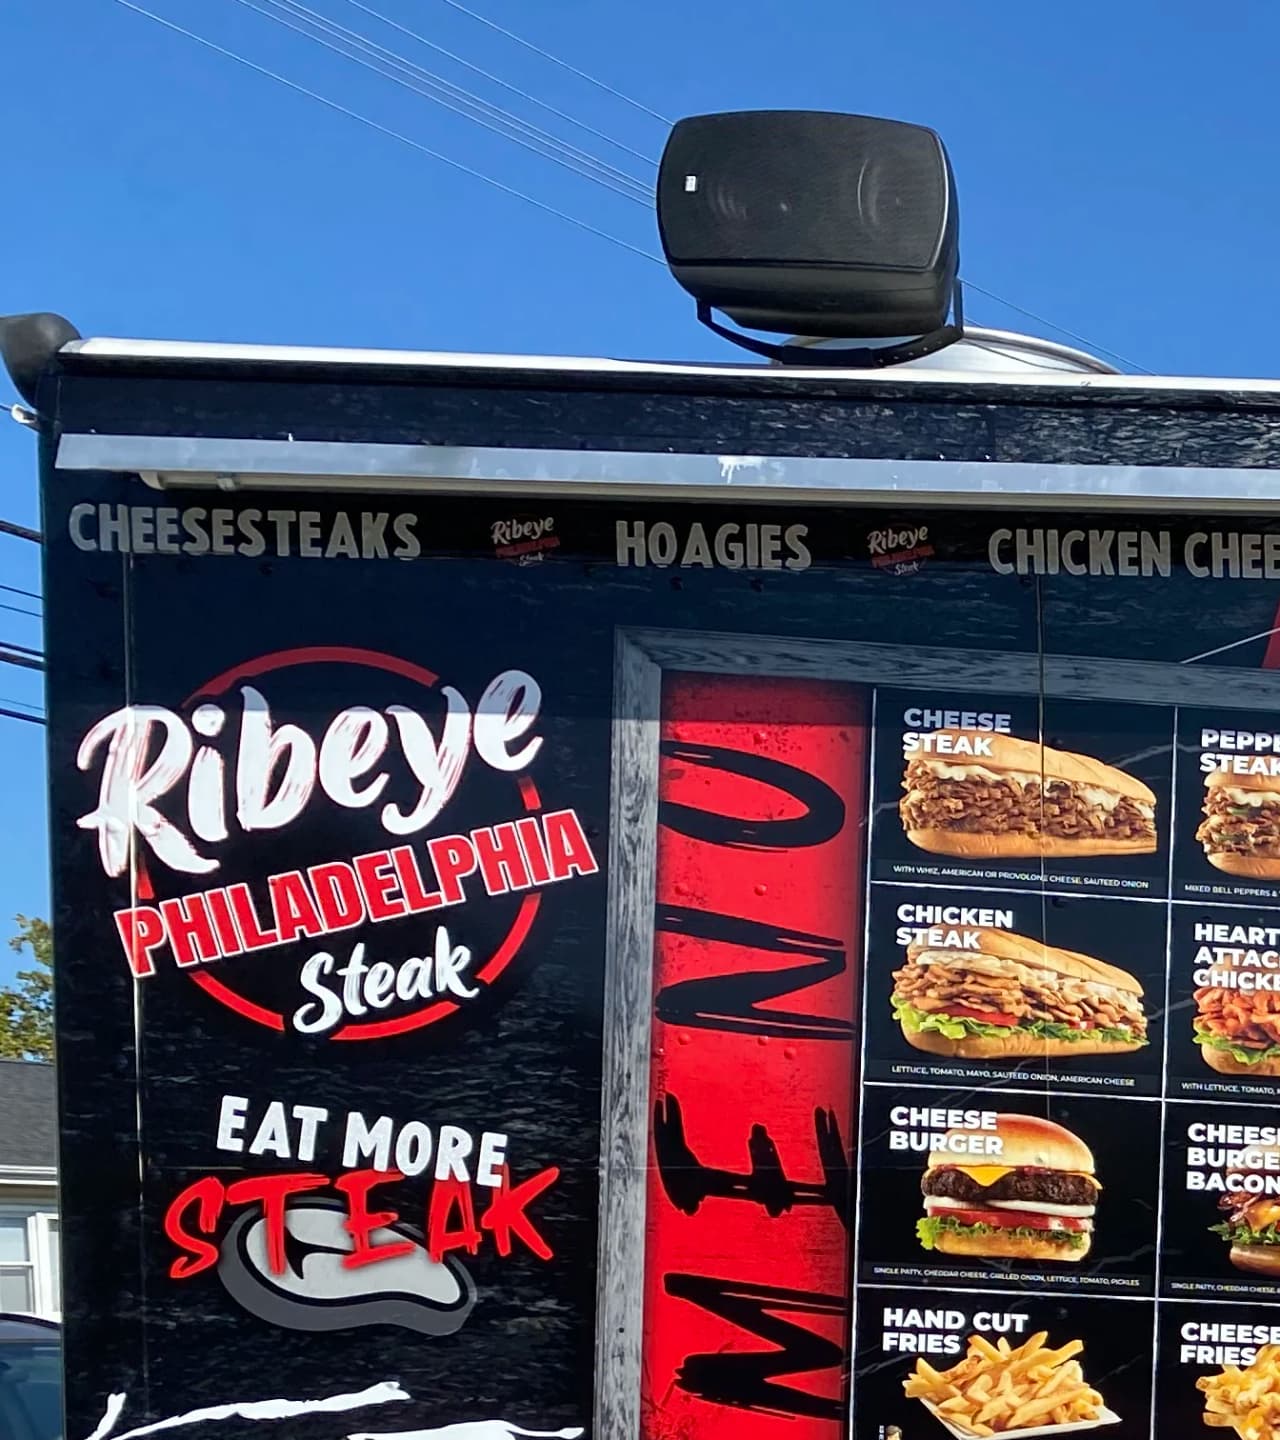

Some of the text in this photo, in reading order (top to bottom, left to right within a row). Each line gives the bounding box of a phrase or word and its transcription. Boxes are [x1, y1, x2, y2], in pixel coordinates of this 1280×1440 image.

[69, 502, 421, 560] CHEESESTEAKS
[615, 520, 812, 571] HOAGIES
[989, 528, 1172, 578] CHICKEN
[902, 707, 1011, 734] CHEESE
[901, 731, 994, 758] STEAK
[76, 668, 543, 880] Ribeye
[113, 807, 599, 979] PHILADELPHIA
[896, 903, 1013, 930] CHICKEN
[895, 926, 982, 951] STEAK
[1193, 922, 1280, 946] HEART
[293, 925, 478, 1034] Steak
[655, 739, 855, 1421] MENU
[889, 1105, 998, 1131] CHEESE
[215, 1095, 508, 1187] EAT MORE
[888, 1130, 1004, 1156] BURGER
[164, 1165, 561, 1281] STEAK
[882, 1308, 1029, 1333] HAND CUT
[881, 1331, 961, 1355] FRIES
[1180, 1343, 1257, 1366] FRIES
